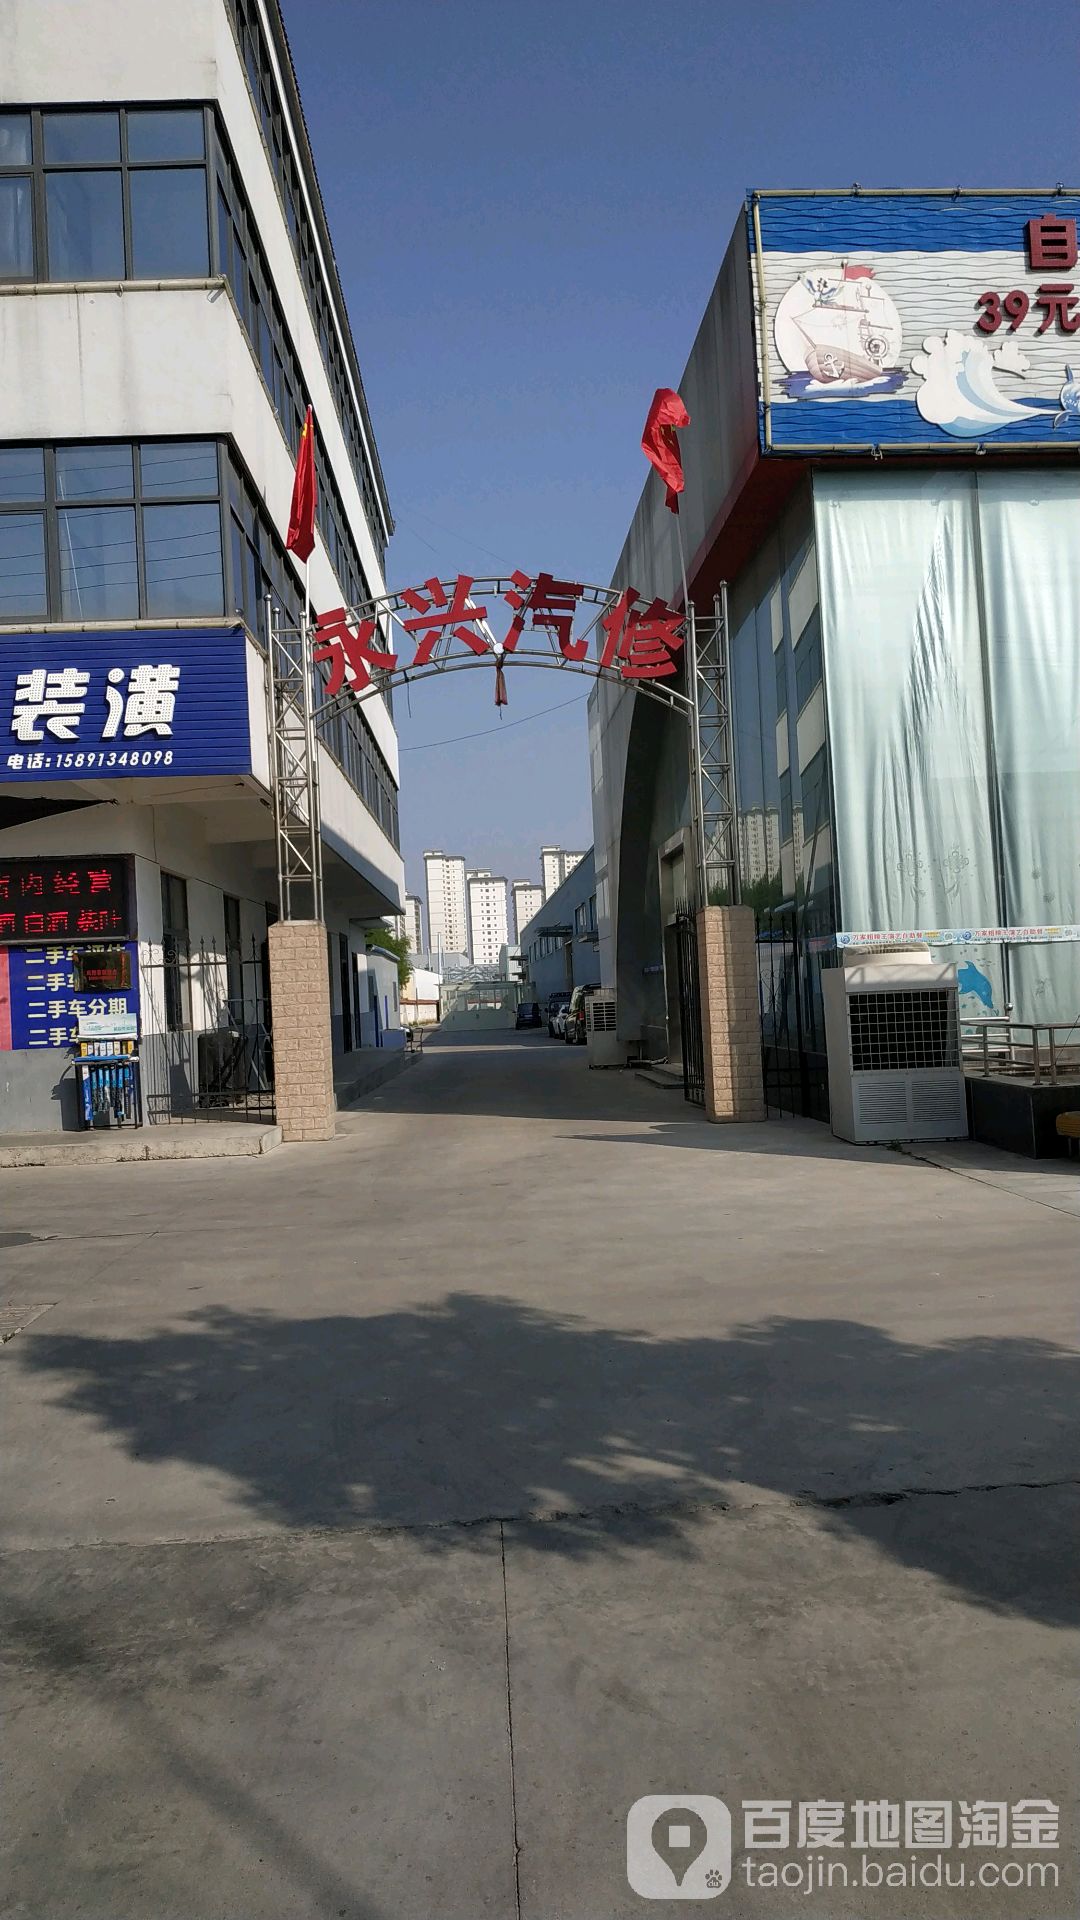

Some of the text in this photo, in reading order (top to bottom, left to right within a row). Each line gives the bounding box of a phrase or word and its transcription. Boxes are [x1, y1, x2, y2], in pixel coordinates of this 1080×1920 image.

[1028, 212, 1078, 269] 自
[976, 283, 1080, 334] 39元
[314, 571, 686, 696] 永兴汽修
[11, 664, 181, 741] 装潢
[27, 998, 128, 1019] 二手车分期
